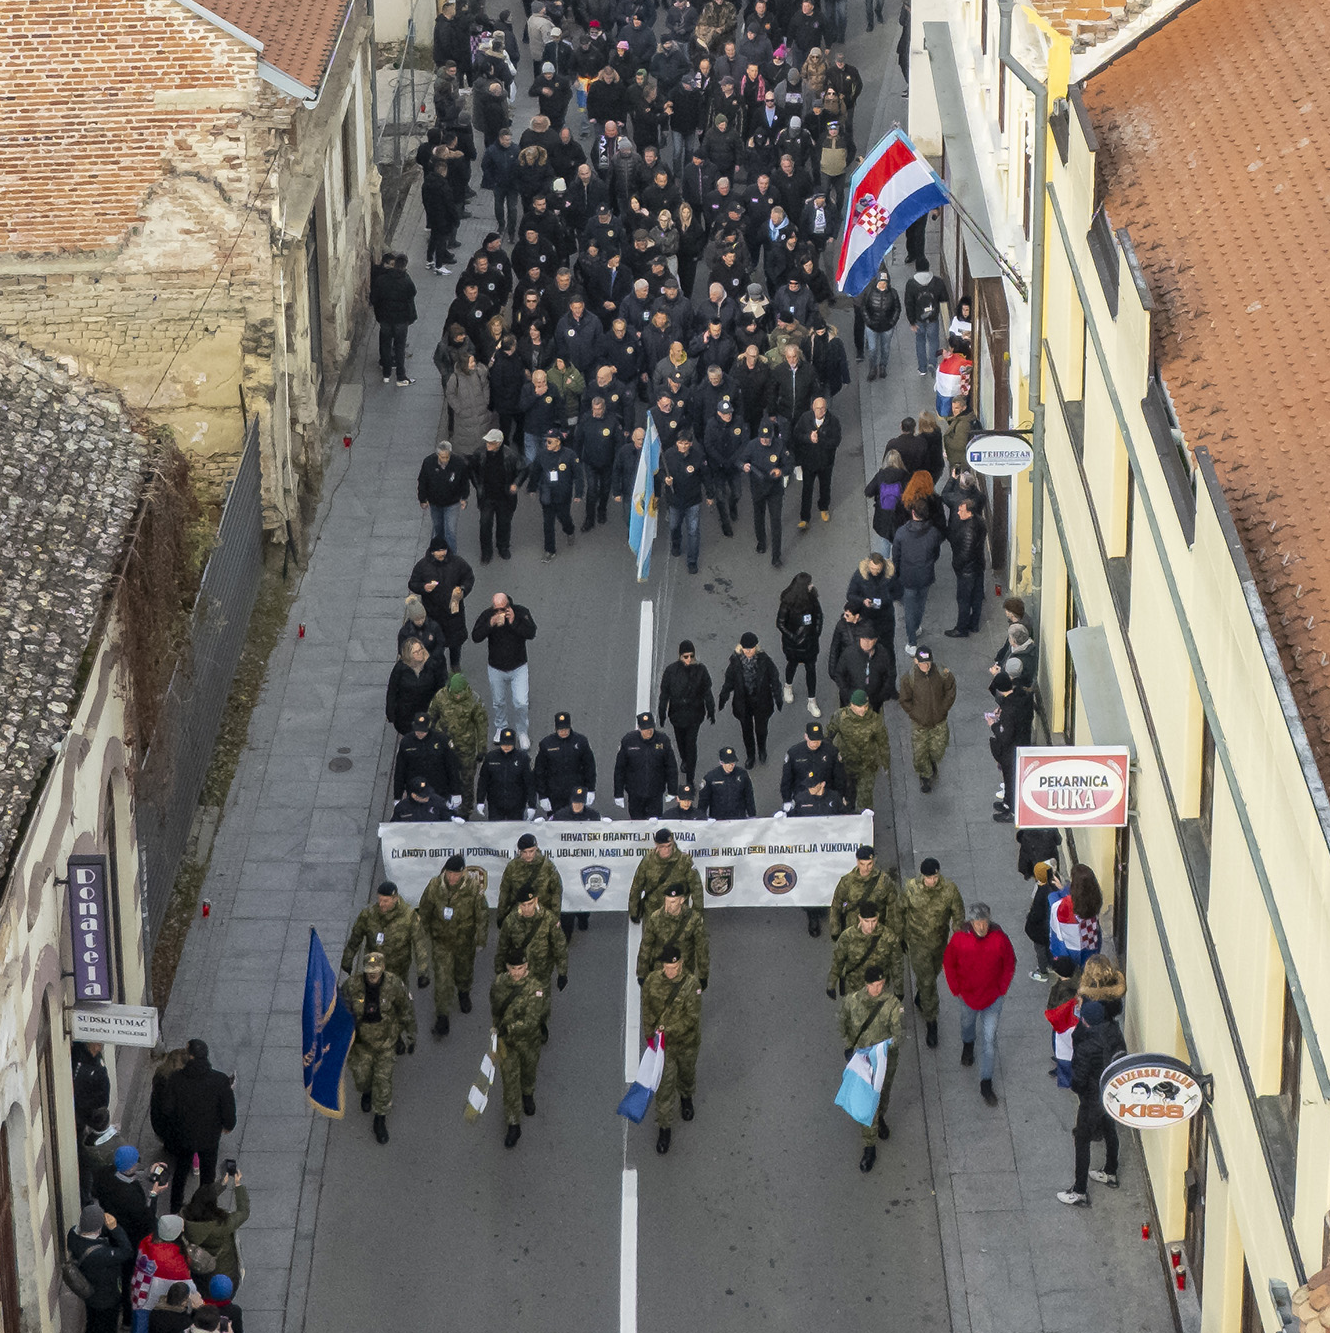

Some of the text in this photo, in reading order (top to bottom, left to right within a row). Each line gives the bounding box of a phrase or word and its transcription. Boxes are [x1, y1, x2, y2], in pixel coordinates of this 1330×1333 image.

[1039, 775, 1109, 788] PEKARNICA
[1047, 788, 1096, 810] LUKA
[560, 832, 601, 842] HRVATSKI
[602, 832, 650, 842] BRANITELJI
[391, 847, 427, 859] ČLANOVI
[598, 847, 634, 857] NASILNO
[721, 845, 766, 857] HRVATSKIH
[768, 843, 818, 854] BRANITELJA
[76, 868, 102, 996] Donatela
[77, 1015, 147, 1027] SUDSKI TUMAČ
[1110, 1069, 1196, 1089] FRIZERSKI SALON
